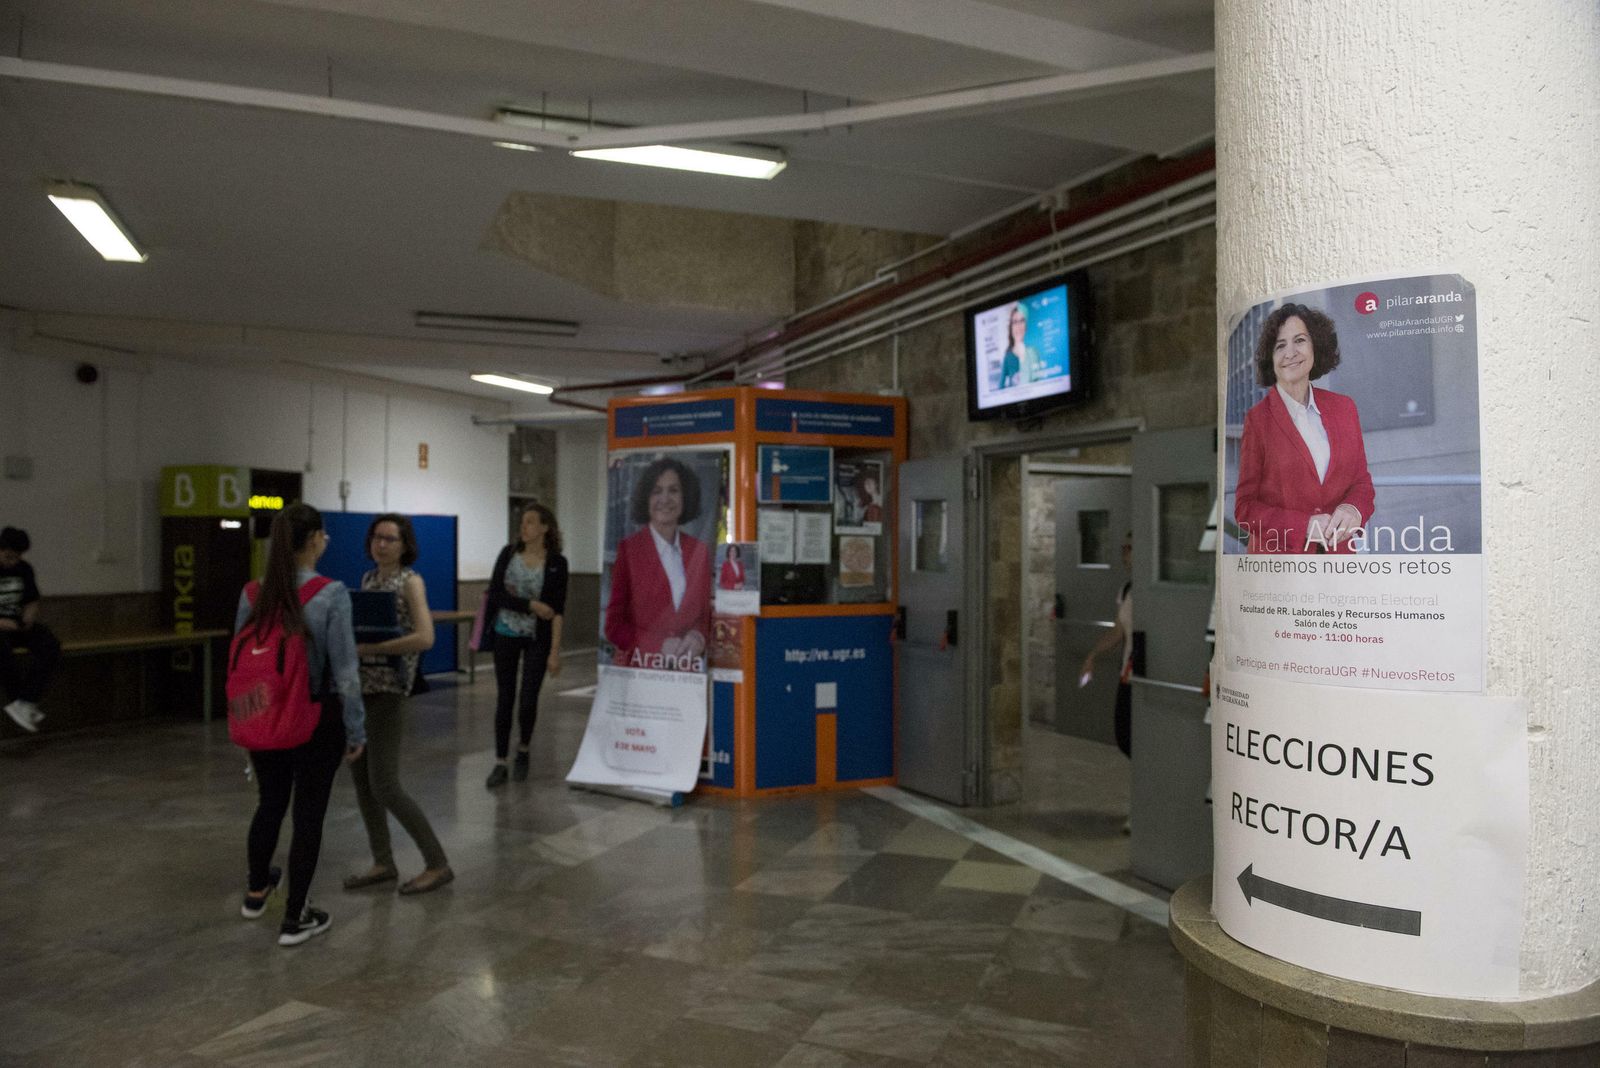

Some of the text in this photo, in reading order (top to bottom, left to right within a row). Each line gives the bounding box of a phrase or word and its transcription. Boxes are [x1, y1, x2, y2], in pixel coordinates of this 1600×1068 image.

[1386, 291, 1462, 310] pilar aranda
[1380, 314, 1453, 329] @PilarArandaUGR
[1366, 325, 1454, 339] www.pilararanda.info
[1237, 516, 1455, 553] Pilar Aranda
[1237, 557, 1451, 575] Afrontemos nuevos retos
[1242, 590, 1439, 608] Presentación de Programa Electoral
[1240, 604, 1445, 620] Facultad de RR. Laborales y Recursos Humanos
[1294, 618, 1358, 630] Salón de Actos
[1274, 631, 1384, 644] 6 de mayo 11:00 horas
[630, 647, 704, 672] Aranda
[1236, 655, 1455, 682] Participa en #RectoraUGR #NuevosRetos
[1226, 722, 1434, 786] ELECCIONES
[1231, 791, 1411, 860] RECTOR/A
